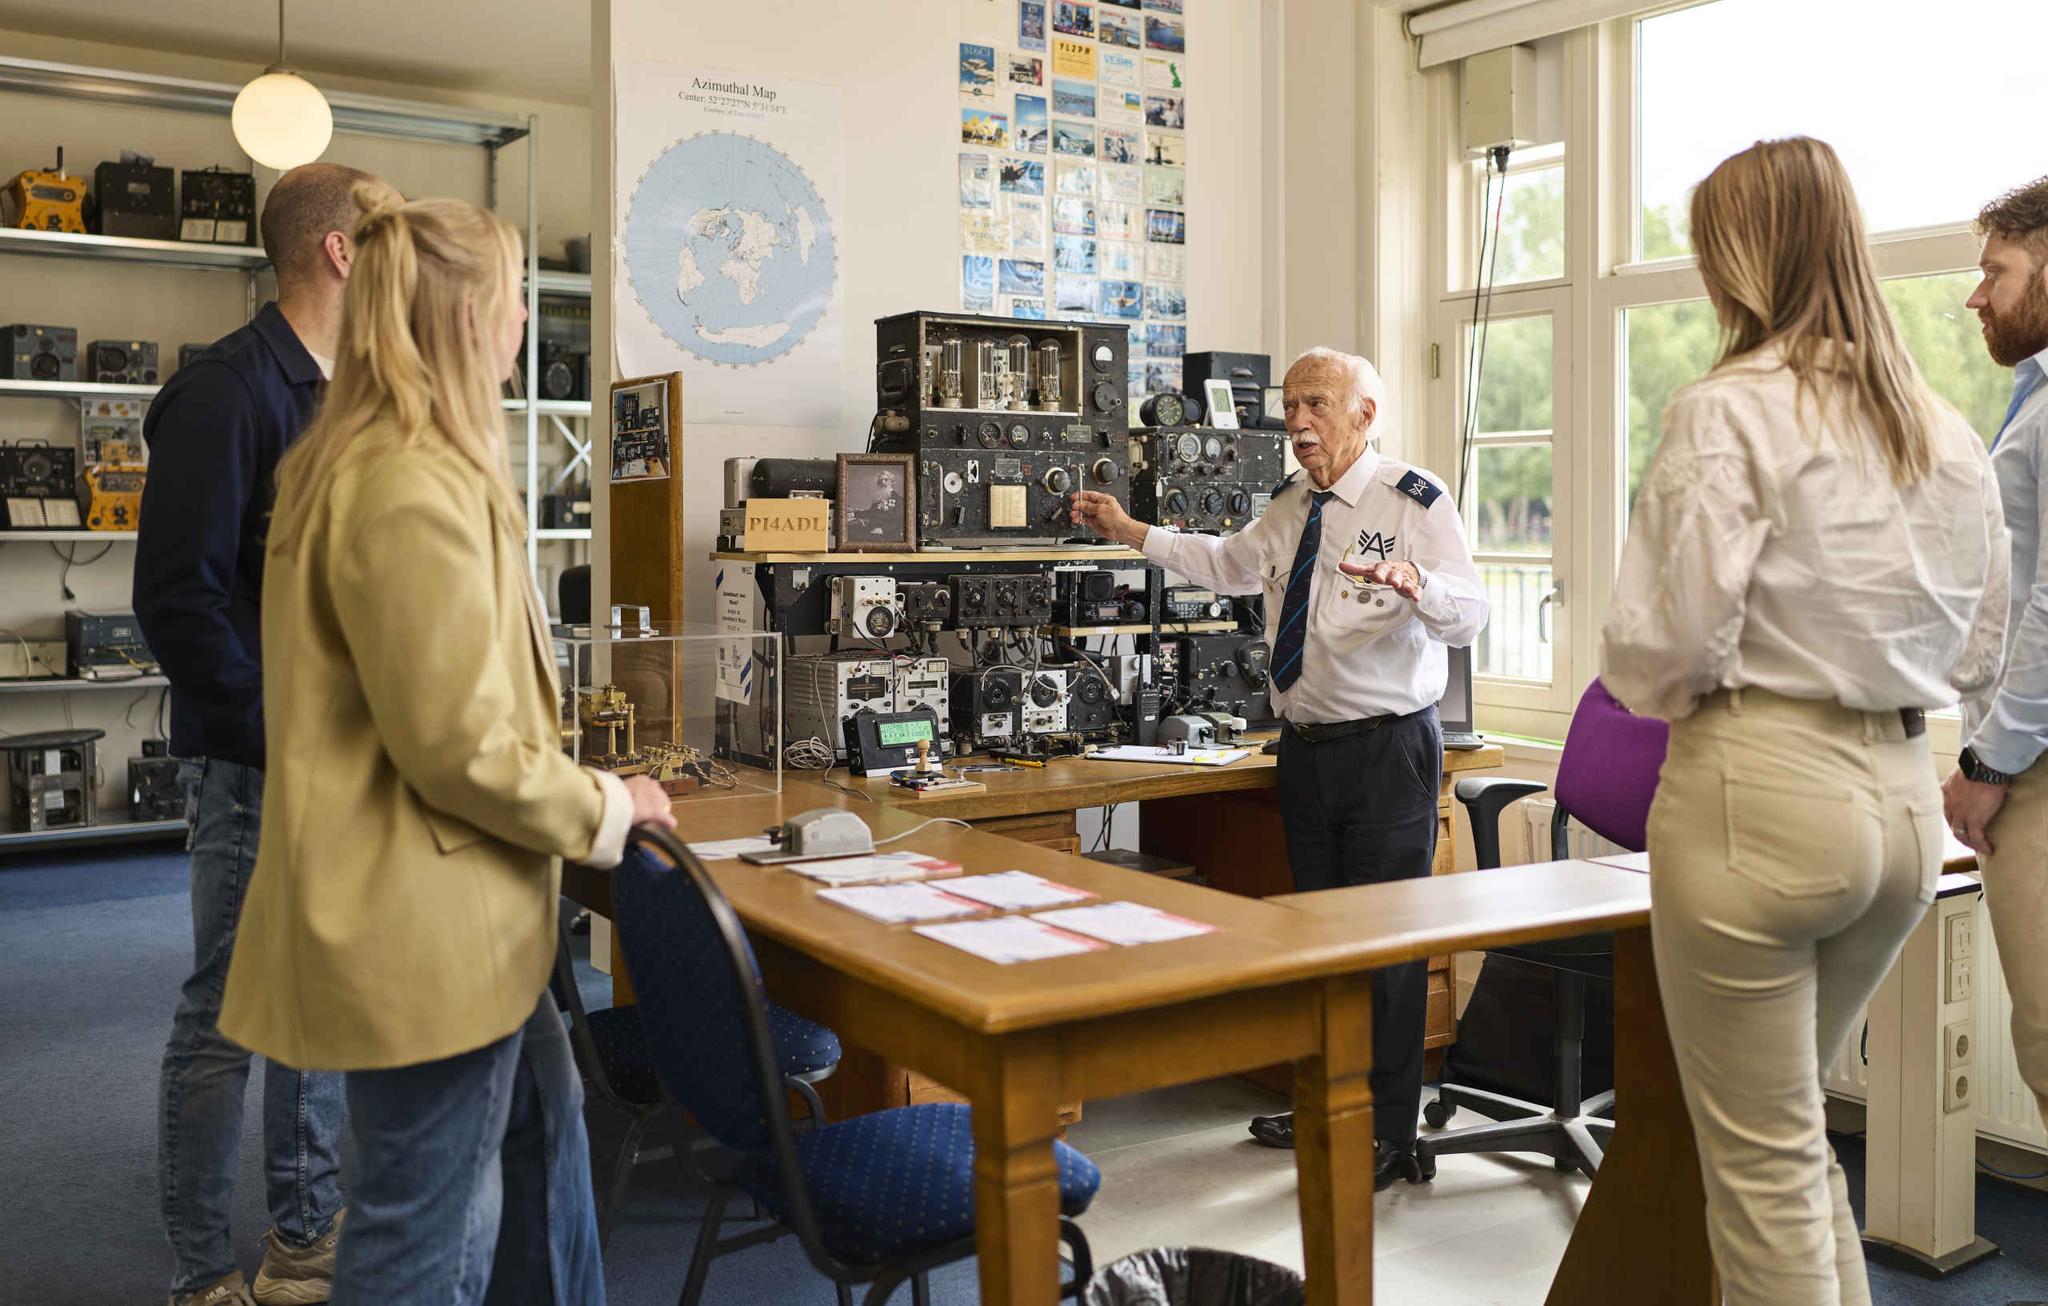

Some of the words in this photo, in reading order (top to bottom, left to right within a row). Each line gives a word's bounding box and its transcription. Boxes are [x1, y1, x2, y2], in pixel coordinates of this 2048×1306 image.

[678, 91, 706, 103] Center:
[691, 77, 749, 96] Azimuthal
[752, 85, 777, 102] Map
[749, 517, 825, 532] PI4ADL
